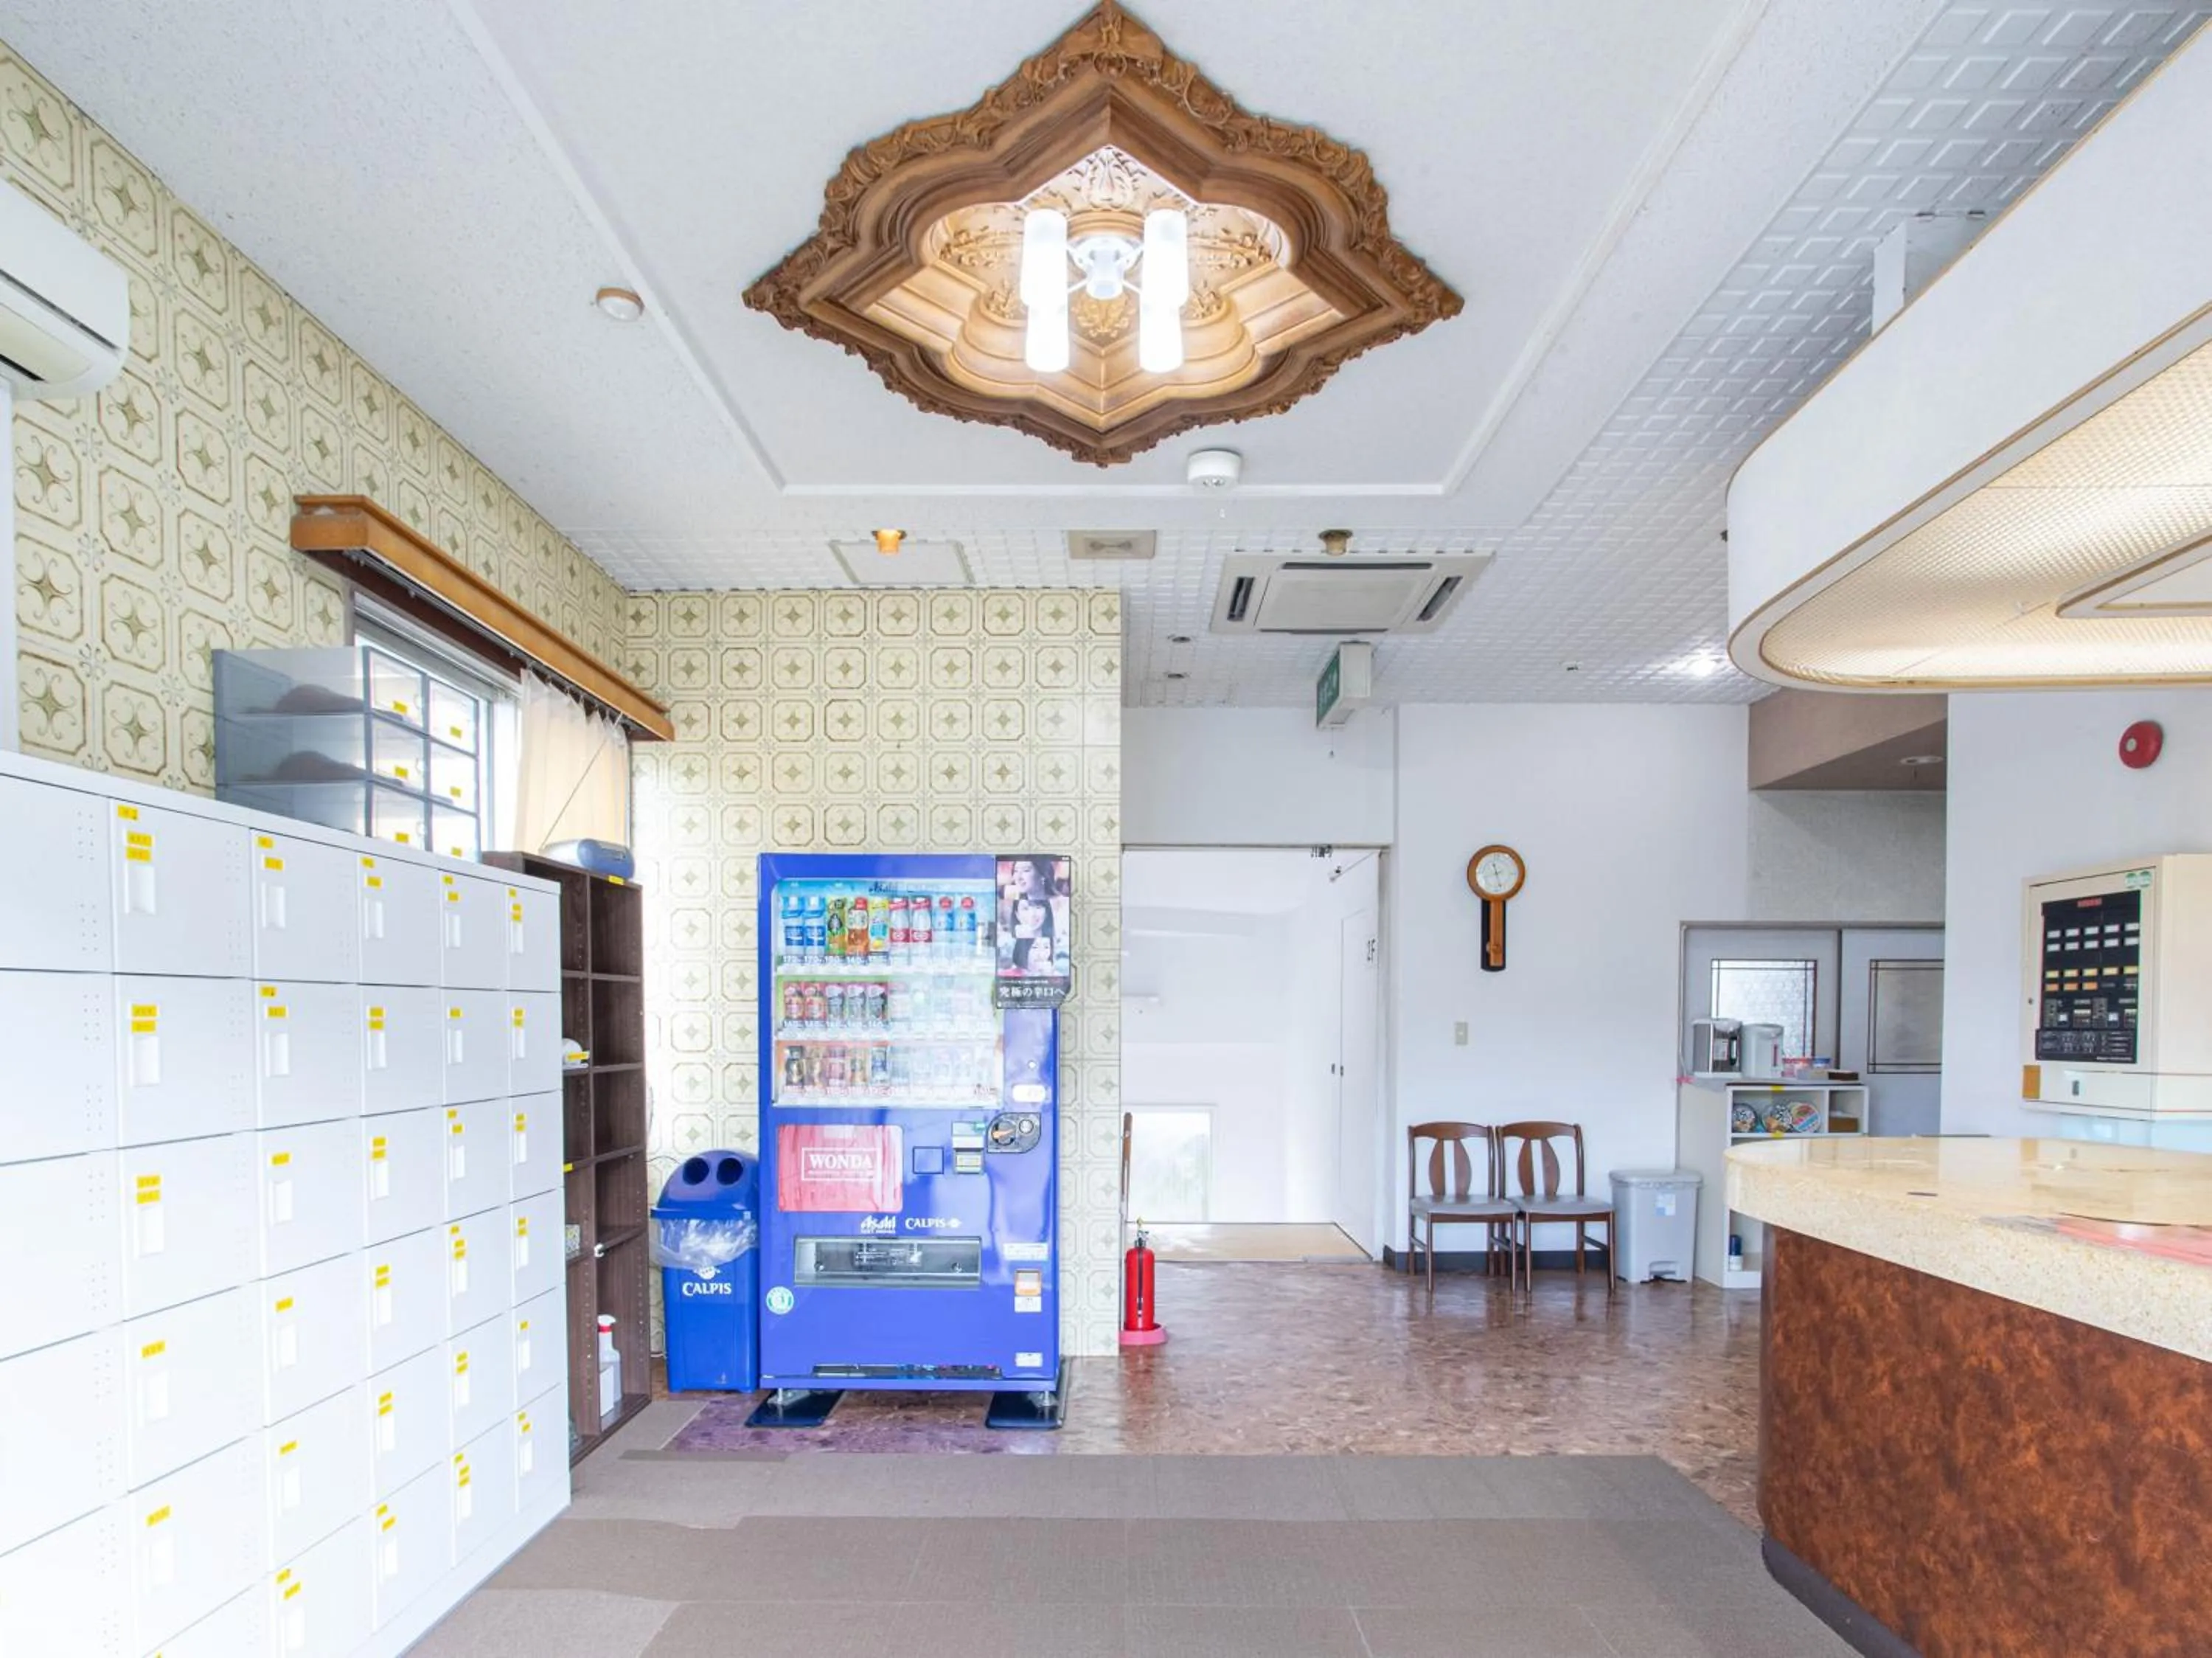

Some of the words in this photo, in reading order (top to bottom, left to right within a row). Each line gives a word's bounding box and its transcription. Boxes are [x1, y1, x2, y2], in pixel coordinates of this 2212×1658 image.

[999, 986, 1065, 999] 究極の辛口へ
[810, 1154, 873, 1169] WONDA
[860, 1215, 896, 1229] Asahi
[905, 1218, 945, 1230] CALPIS
[682, 1281, 732, 1297] CALPIS
